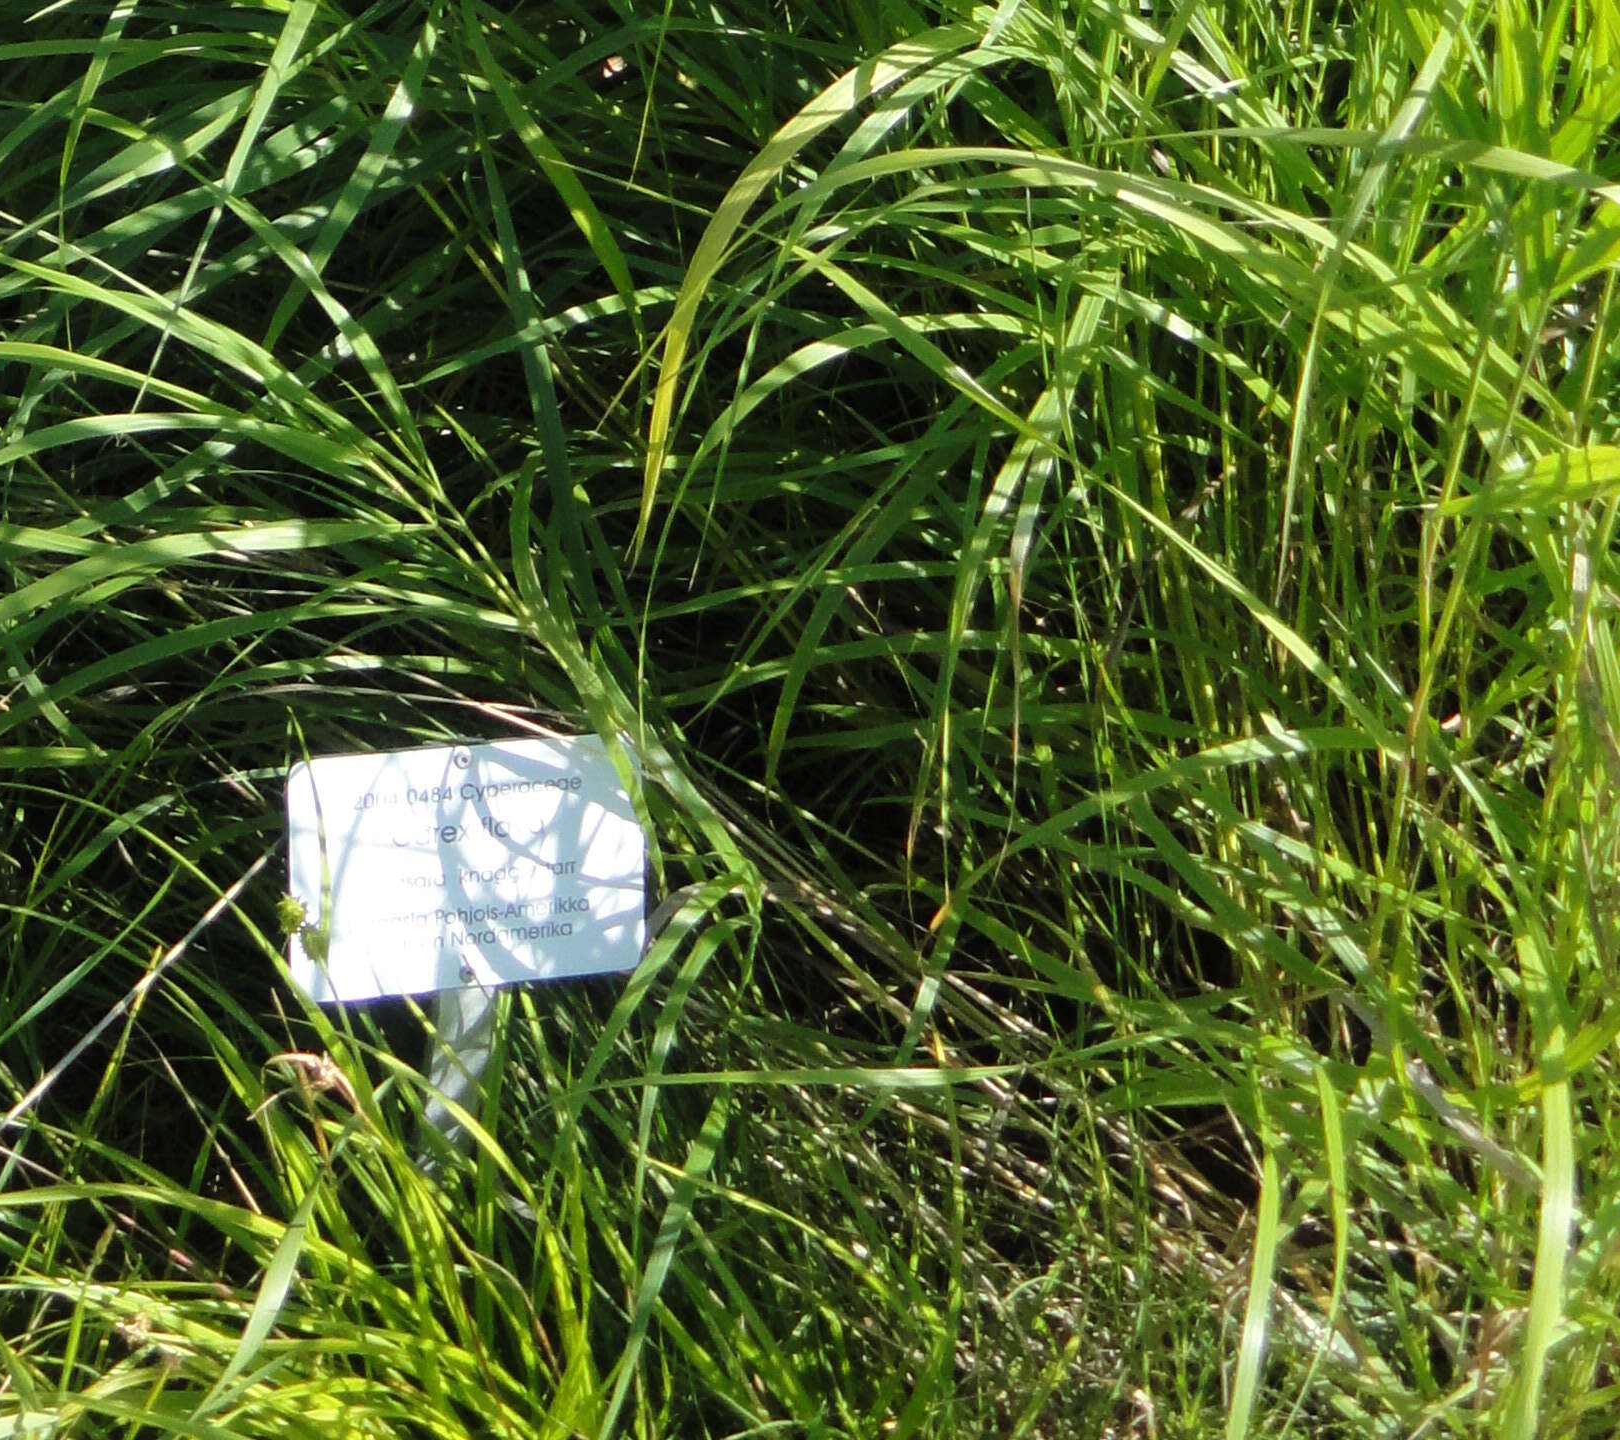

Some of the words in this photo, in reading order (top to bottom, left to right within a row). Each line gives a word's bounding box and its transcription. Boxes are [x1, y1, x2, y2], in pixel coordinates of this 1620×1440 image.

[460, 776, 582, 802] Cyperaceae
[435, 896, 590, 926] Pohjois-Amerikka
[451, 921, 573, 948] Nordamerika
